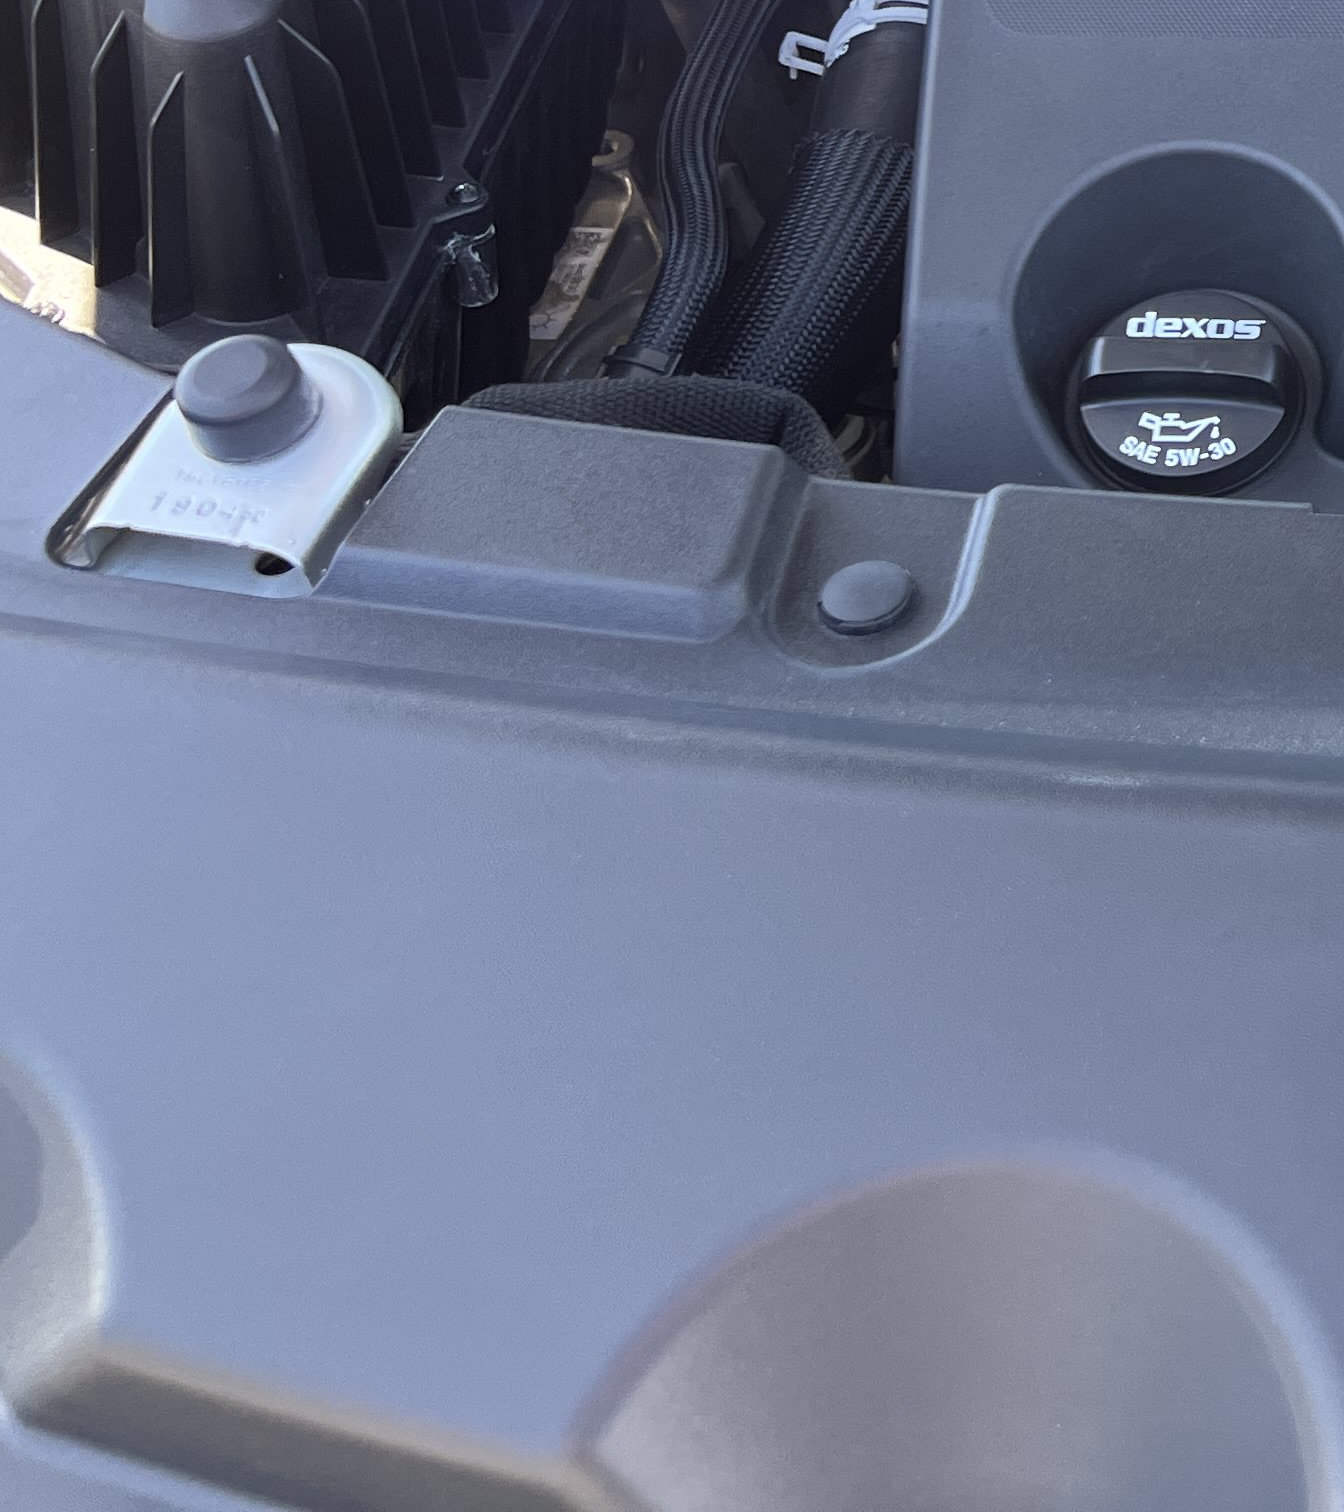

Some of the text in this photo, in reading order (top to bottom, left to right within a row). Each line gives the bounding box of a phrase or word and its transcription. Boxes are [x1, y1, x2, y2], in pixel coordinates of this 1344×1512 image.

[1126, 311, 1266, 340] dexos
[1119, 435, 1237, 467] SAE 5W-30
